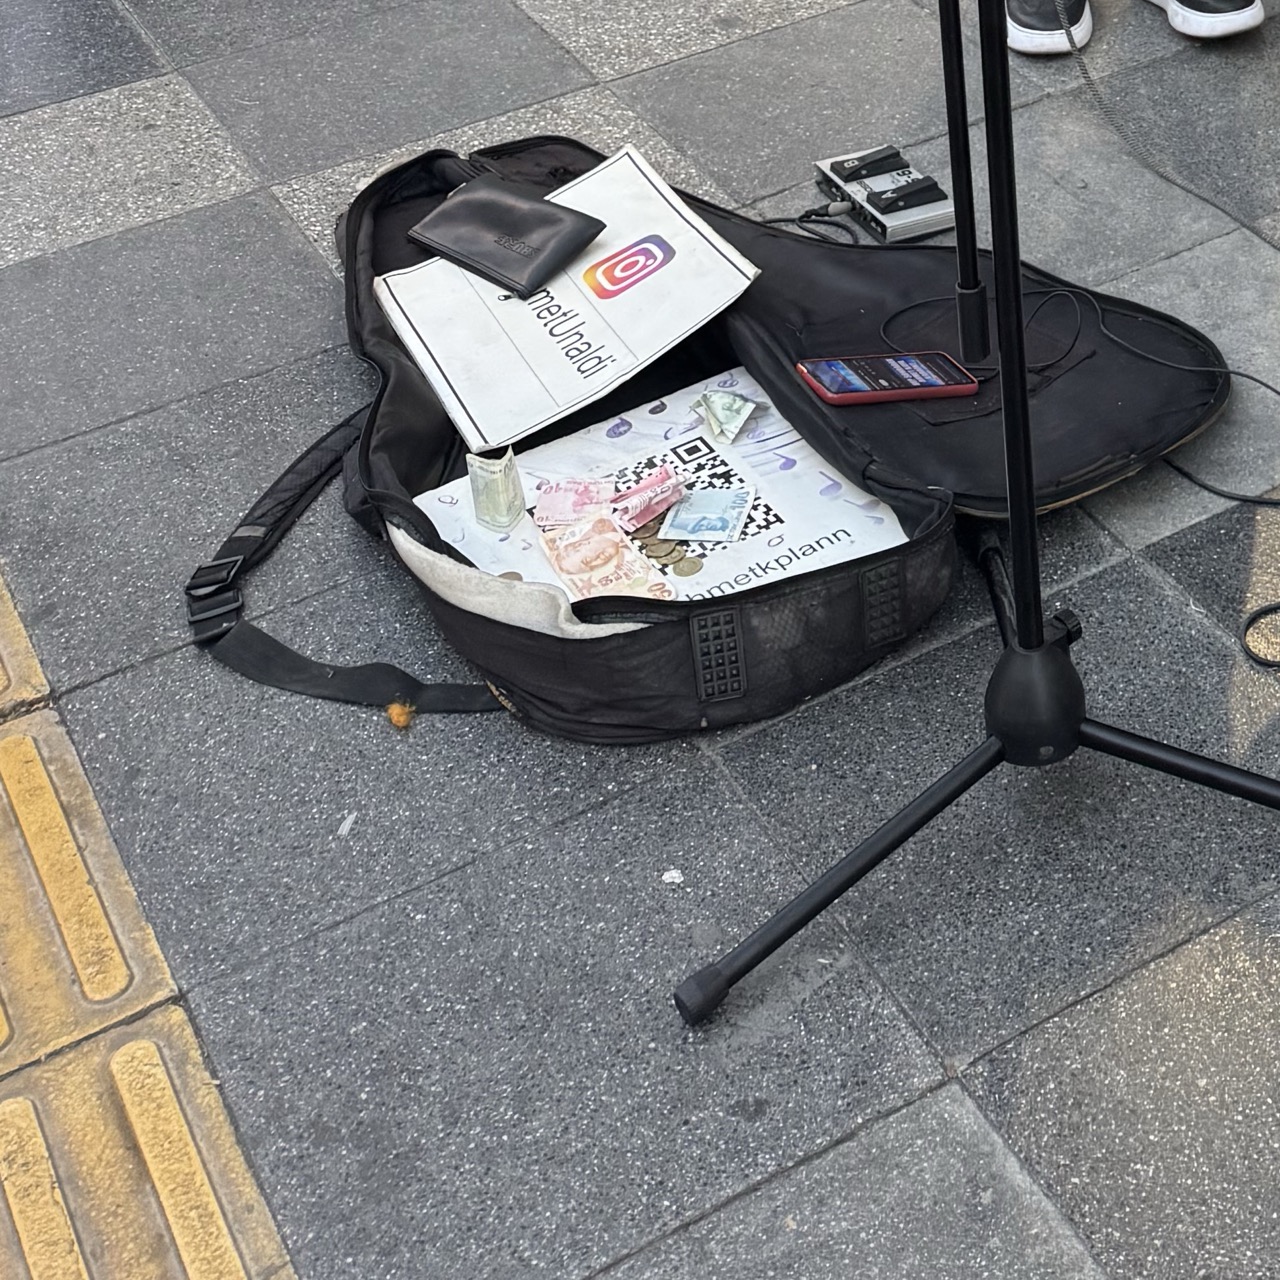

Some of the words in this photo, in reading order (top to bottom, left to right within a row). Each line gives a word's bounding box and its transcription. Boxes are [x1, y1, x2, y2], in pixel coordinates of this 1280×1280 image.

[843, 158, 860, 170] B
[880, 189, 899, 200] A
[493, 233, 541, 260] SHURE
[730, 490, 751, 512] 100
